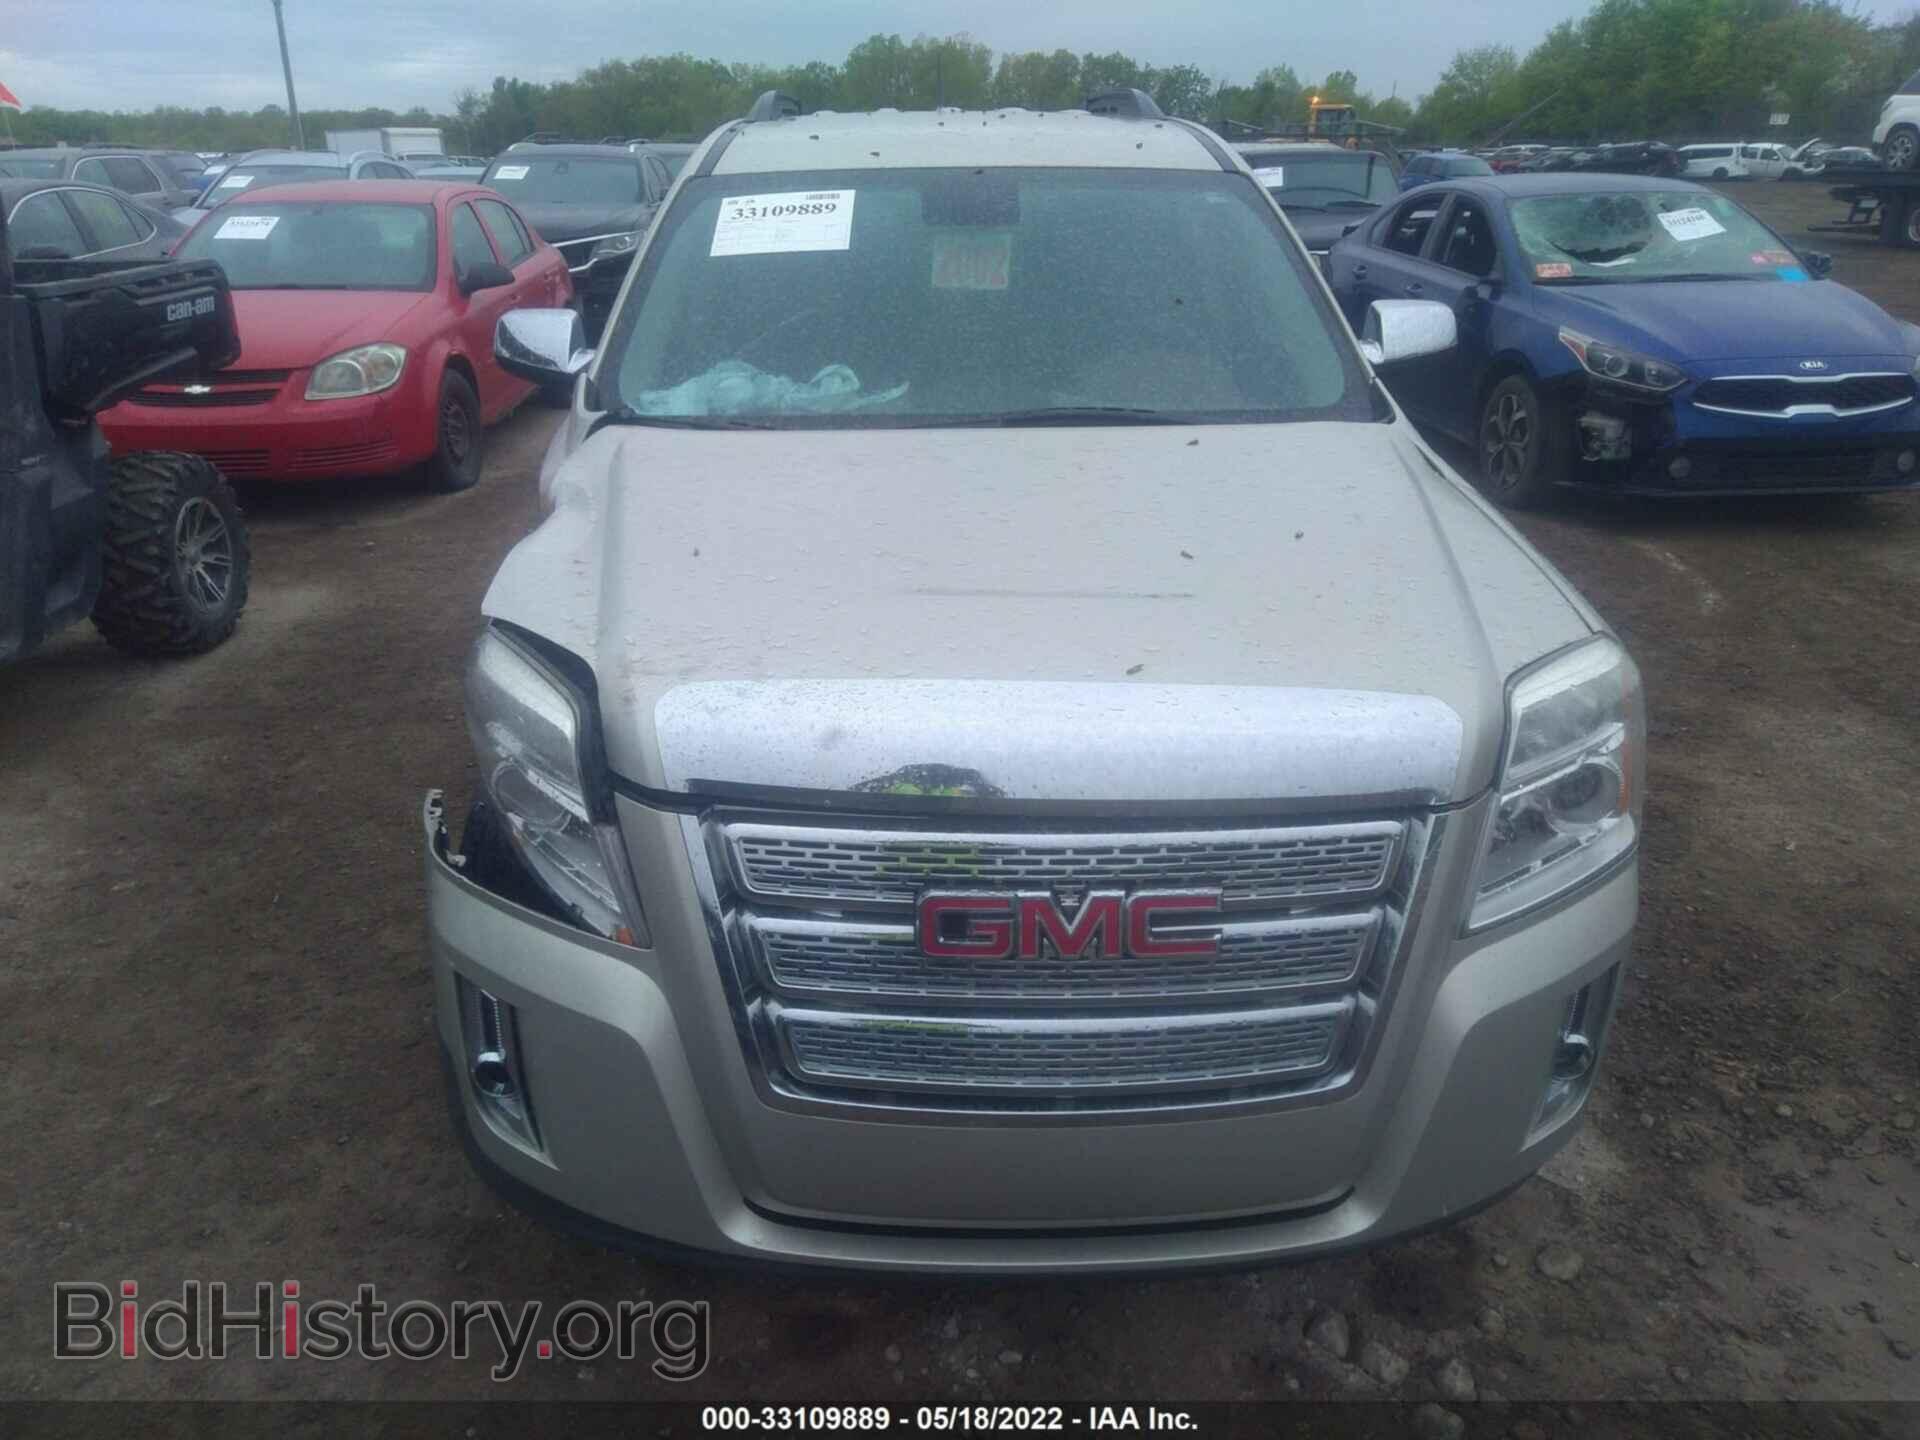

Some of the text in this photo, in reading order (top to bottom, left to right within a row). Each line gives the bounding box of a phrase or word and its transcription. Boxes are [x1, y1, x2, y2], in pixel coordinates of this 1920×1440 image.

[731, 202, 837, 220] 33109889
[167, 296, 215, 321] can-am
[918, 889, 1223, 958] GMC
